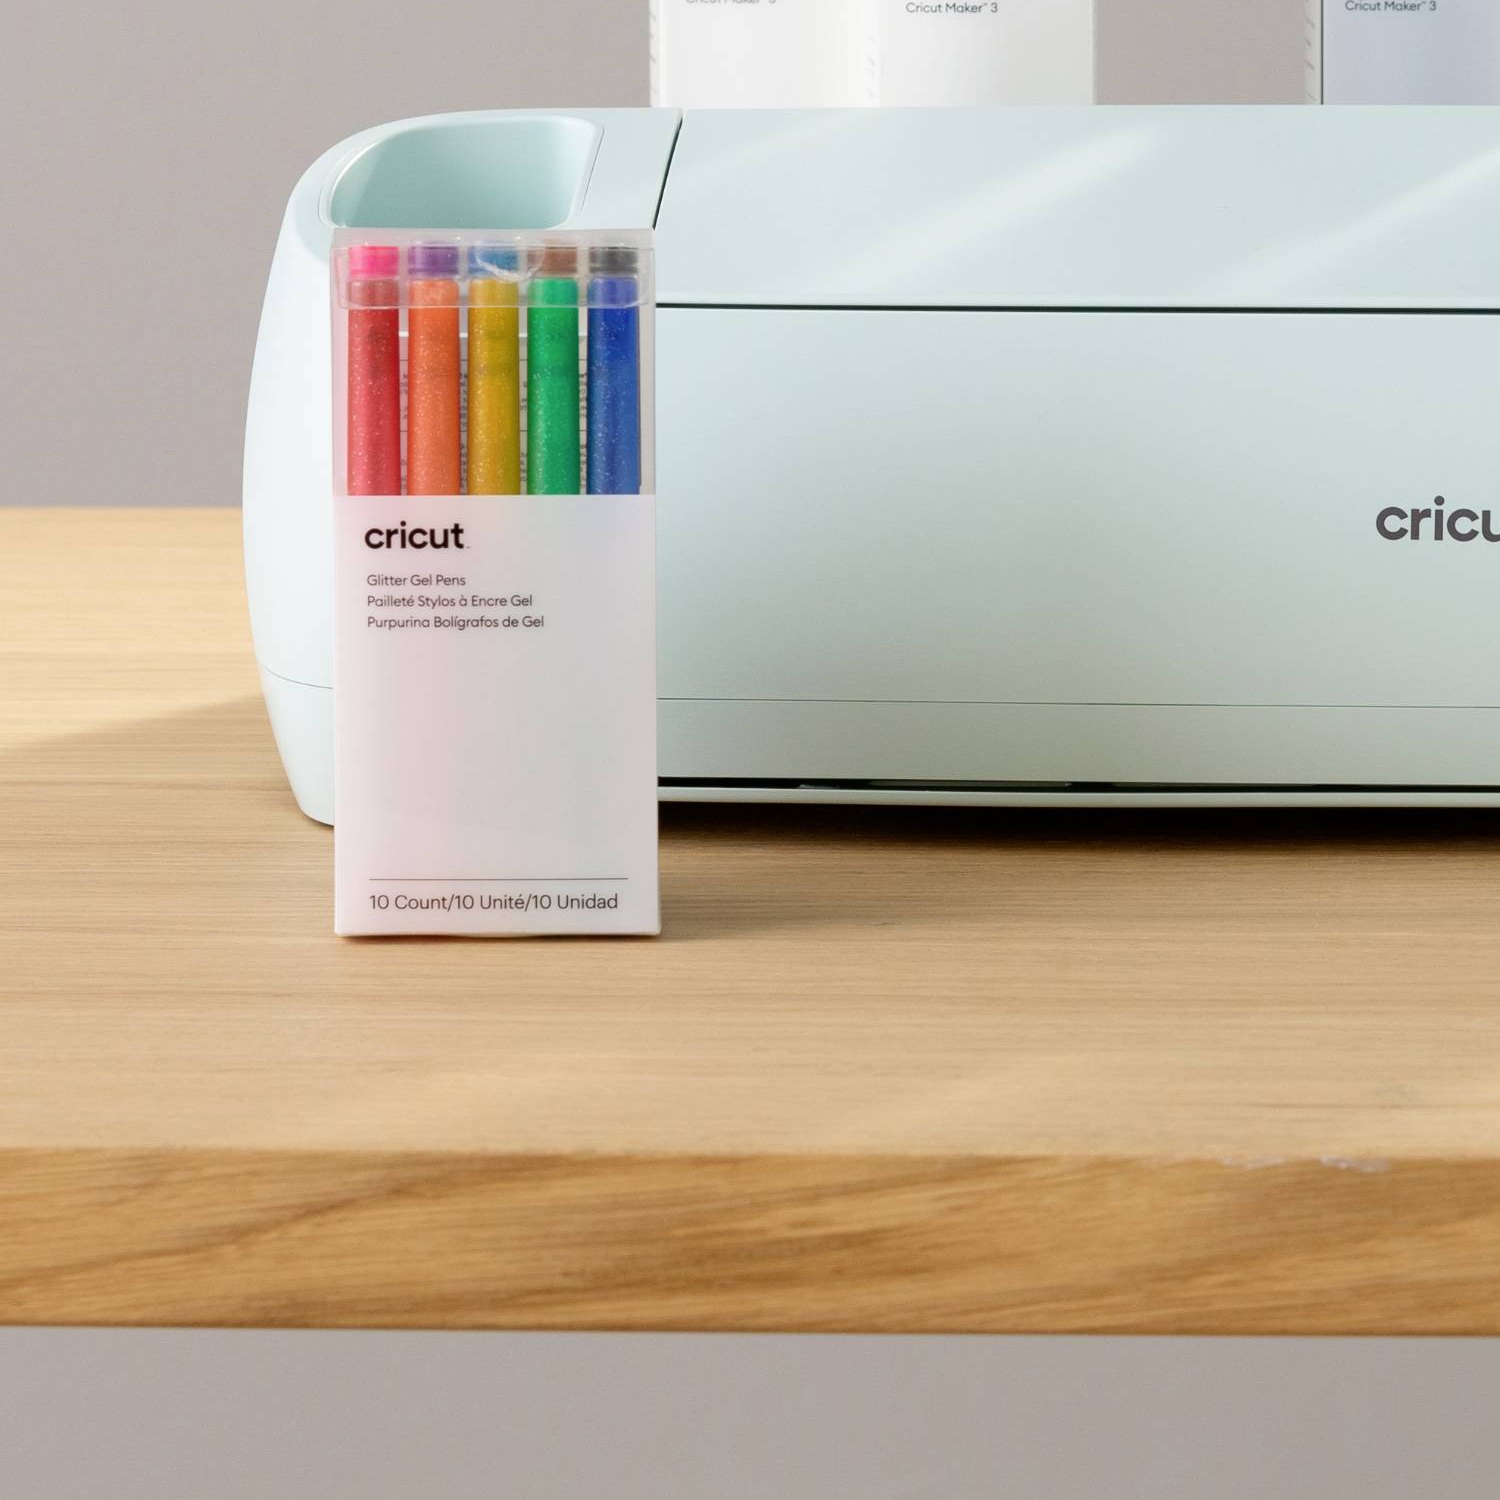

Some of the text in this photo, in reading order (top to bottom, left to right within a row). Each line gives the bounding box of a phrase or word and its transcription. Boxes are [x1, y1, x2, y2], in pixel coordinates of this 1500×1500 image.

[364, 520, 464, 549] cricut
[366, 574, 466, 587] Glitter Gel Pens
[367, 594, 533, 610] Pailleté Stylos à Encre Gel
[367, 615, 544, 631] Purpurina Bolígrafos de Gel
[369, 893, 618, 912] 10 Count/10 Unité/10 Unidad
